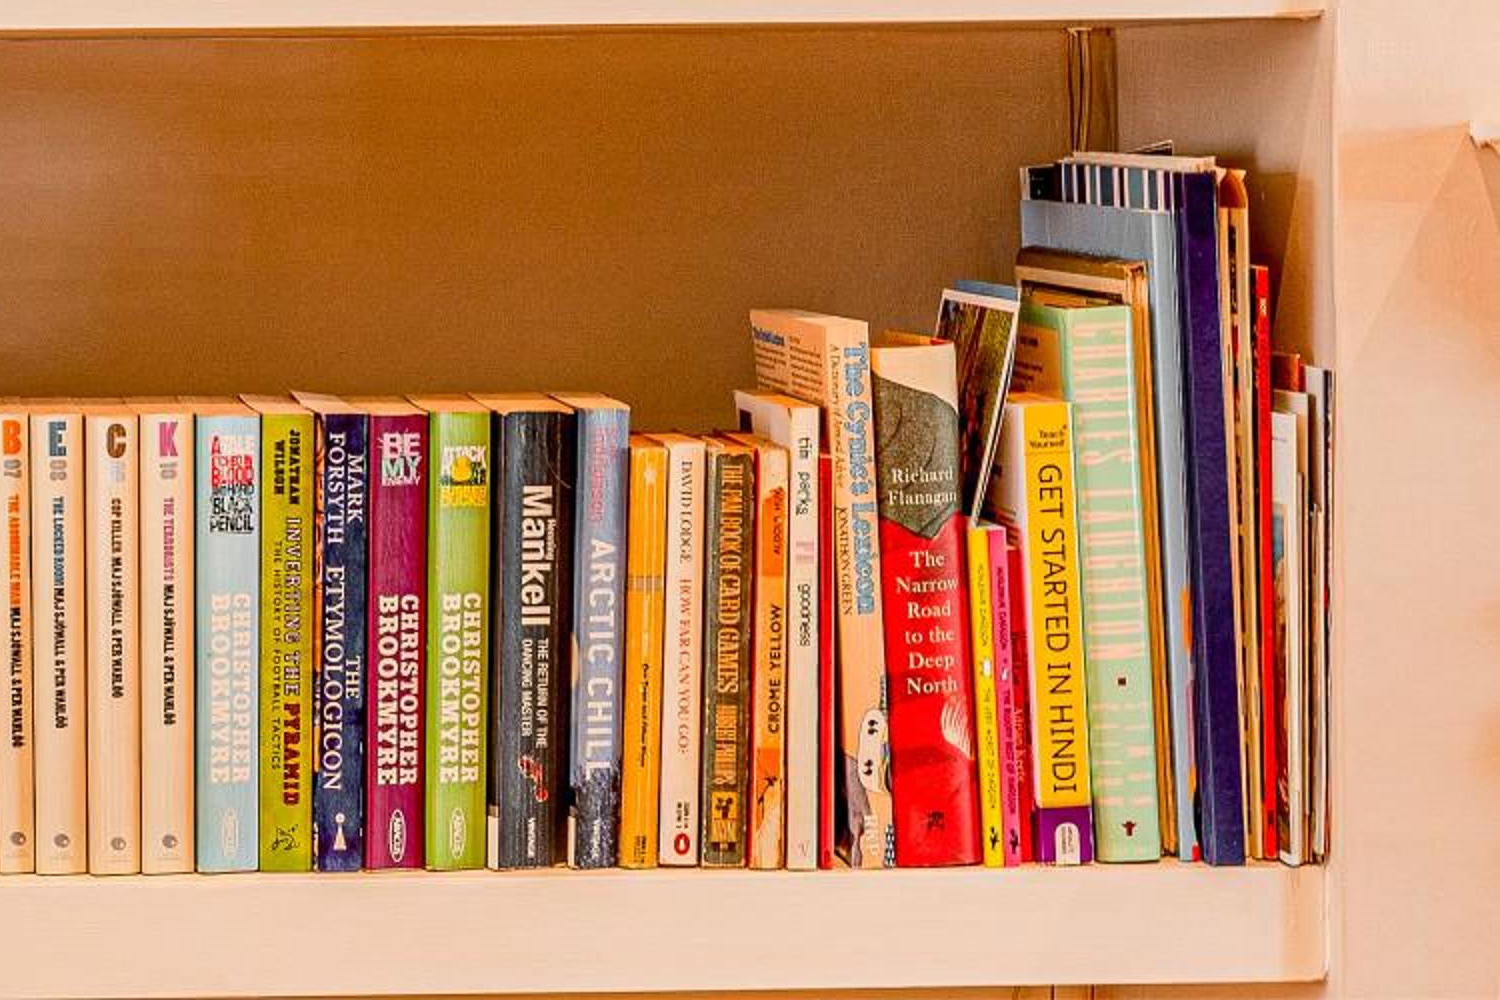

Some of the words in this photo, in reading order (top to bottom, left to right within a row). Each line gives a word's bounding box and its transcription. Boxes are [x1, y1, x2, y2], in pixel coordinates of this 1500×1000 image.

[844, 401, 872, 496] Cynic's
[891, 468, 952, 482] Richard
[327, 432, 344, 544] FORSYTH
[347, 454, 362, 522] MARK
[888, 490, 956, 505] Flanagan
[1038, 464, 1063, 518] GET
[521, 485, 552, 625] Mankell
[851, 502, 878, 615] Lexicon
[910, 552, 945, 568] The
[587, 539, 614, 662] ARCTIC
[895, 578, 958, 594] Narrow
[906, 602, 951, 618] Road
[1041, 528, 1070, 652] STARTED
[537, 638, 548, 659] THE
[769, 604, 782, 674] YELLOW
[904, 631, 923, 644] to
[927, 626, 955, 643] the
[908, 652, 954, 669] Deep
[322, 565, 345, 790] ETYMOLOGICON
[377, 594, 398, 785] BROOKMYRE
[399, 594, 418, 785] CHRISTOPHER
[440, 593, 460, 784] BROOKMYRE
[461, 592, 482, 784] CHRISTOPHER
[522, 638, 533, 687] DANCING
[536, 662, 548, 706] RETURN
[906, 678, 958, 694] North
[1047, 662, 1071, 694] IN
[521, 690, 532, 736] MASTER
[536, 710, 547, 722] OF
[586, 677, 613, 781] CHILL
[768, 680, 781, 734] CROME
[283, 703, 300, 806] PYRAMID
[535, 726, 547, 748] THE
[1050, 705, 1077, 792] HINDI
